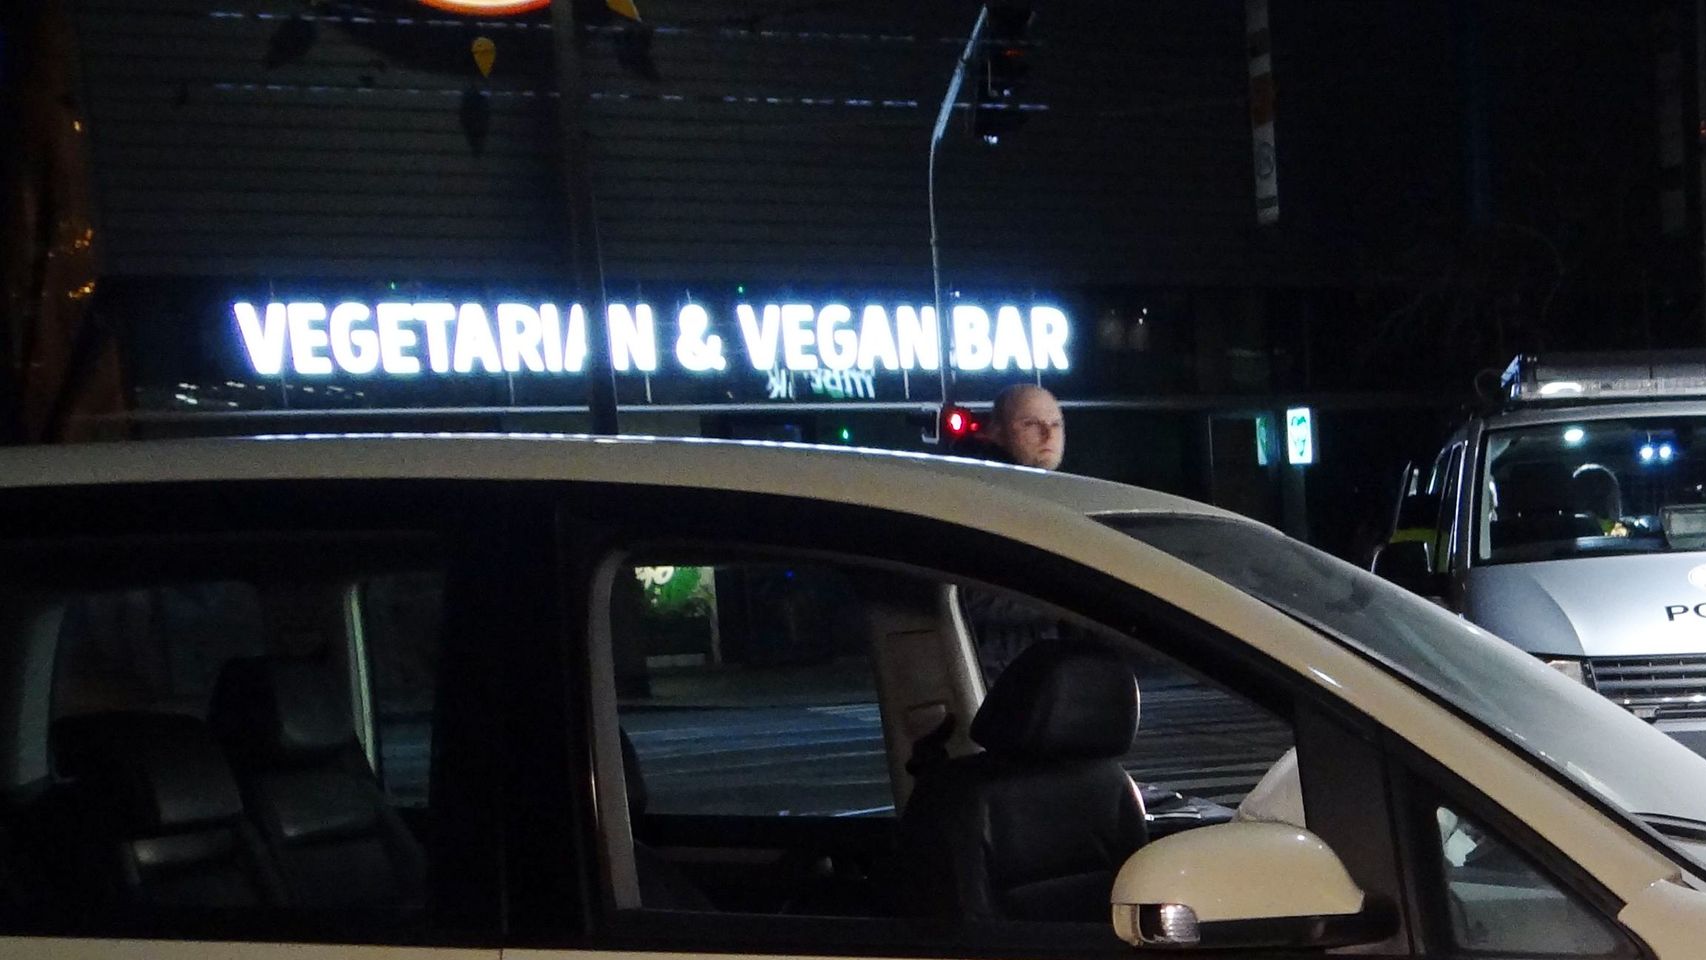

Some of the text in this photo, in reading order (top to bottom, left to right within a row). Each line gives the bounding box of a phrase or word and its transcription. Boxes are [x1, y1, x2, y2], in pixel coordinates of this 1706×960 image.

[675, 303, 727, 371] &
[736, 304, 941, 371] VEGAN
[952, 305, 1070, 371] BAR
